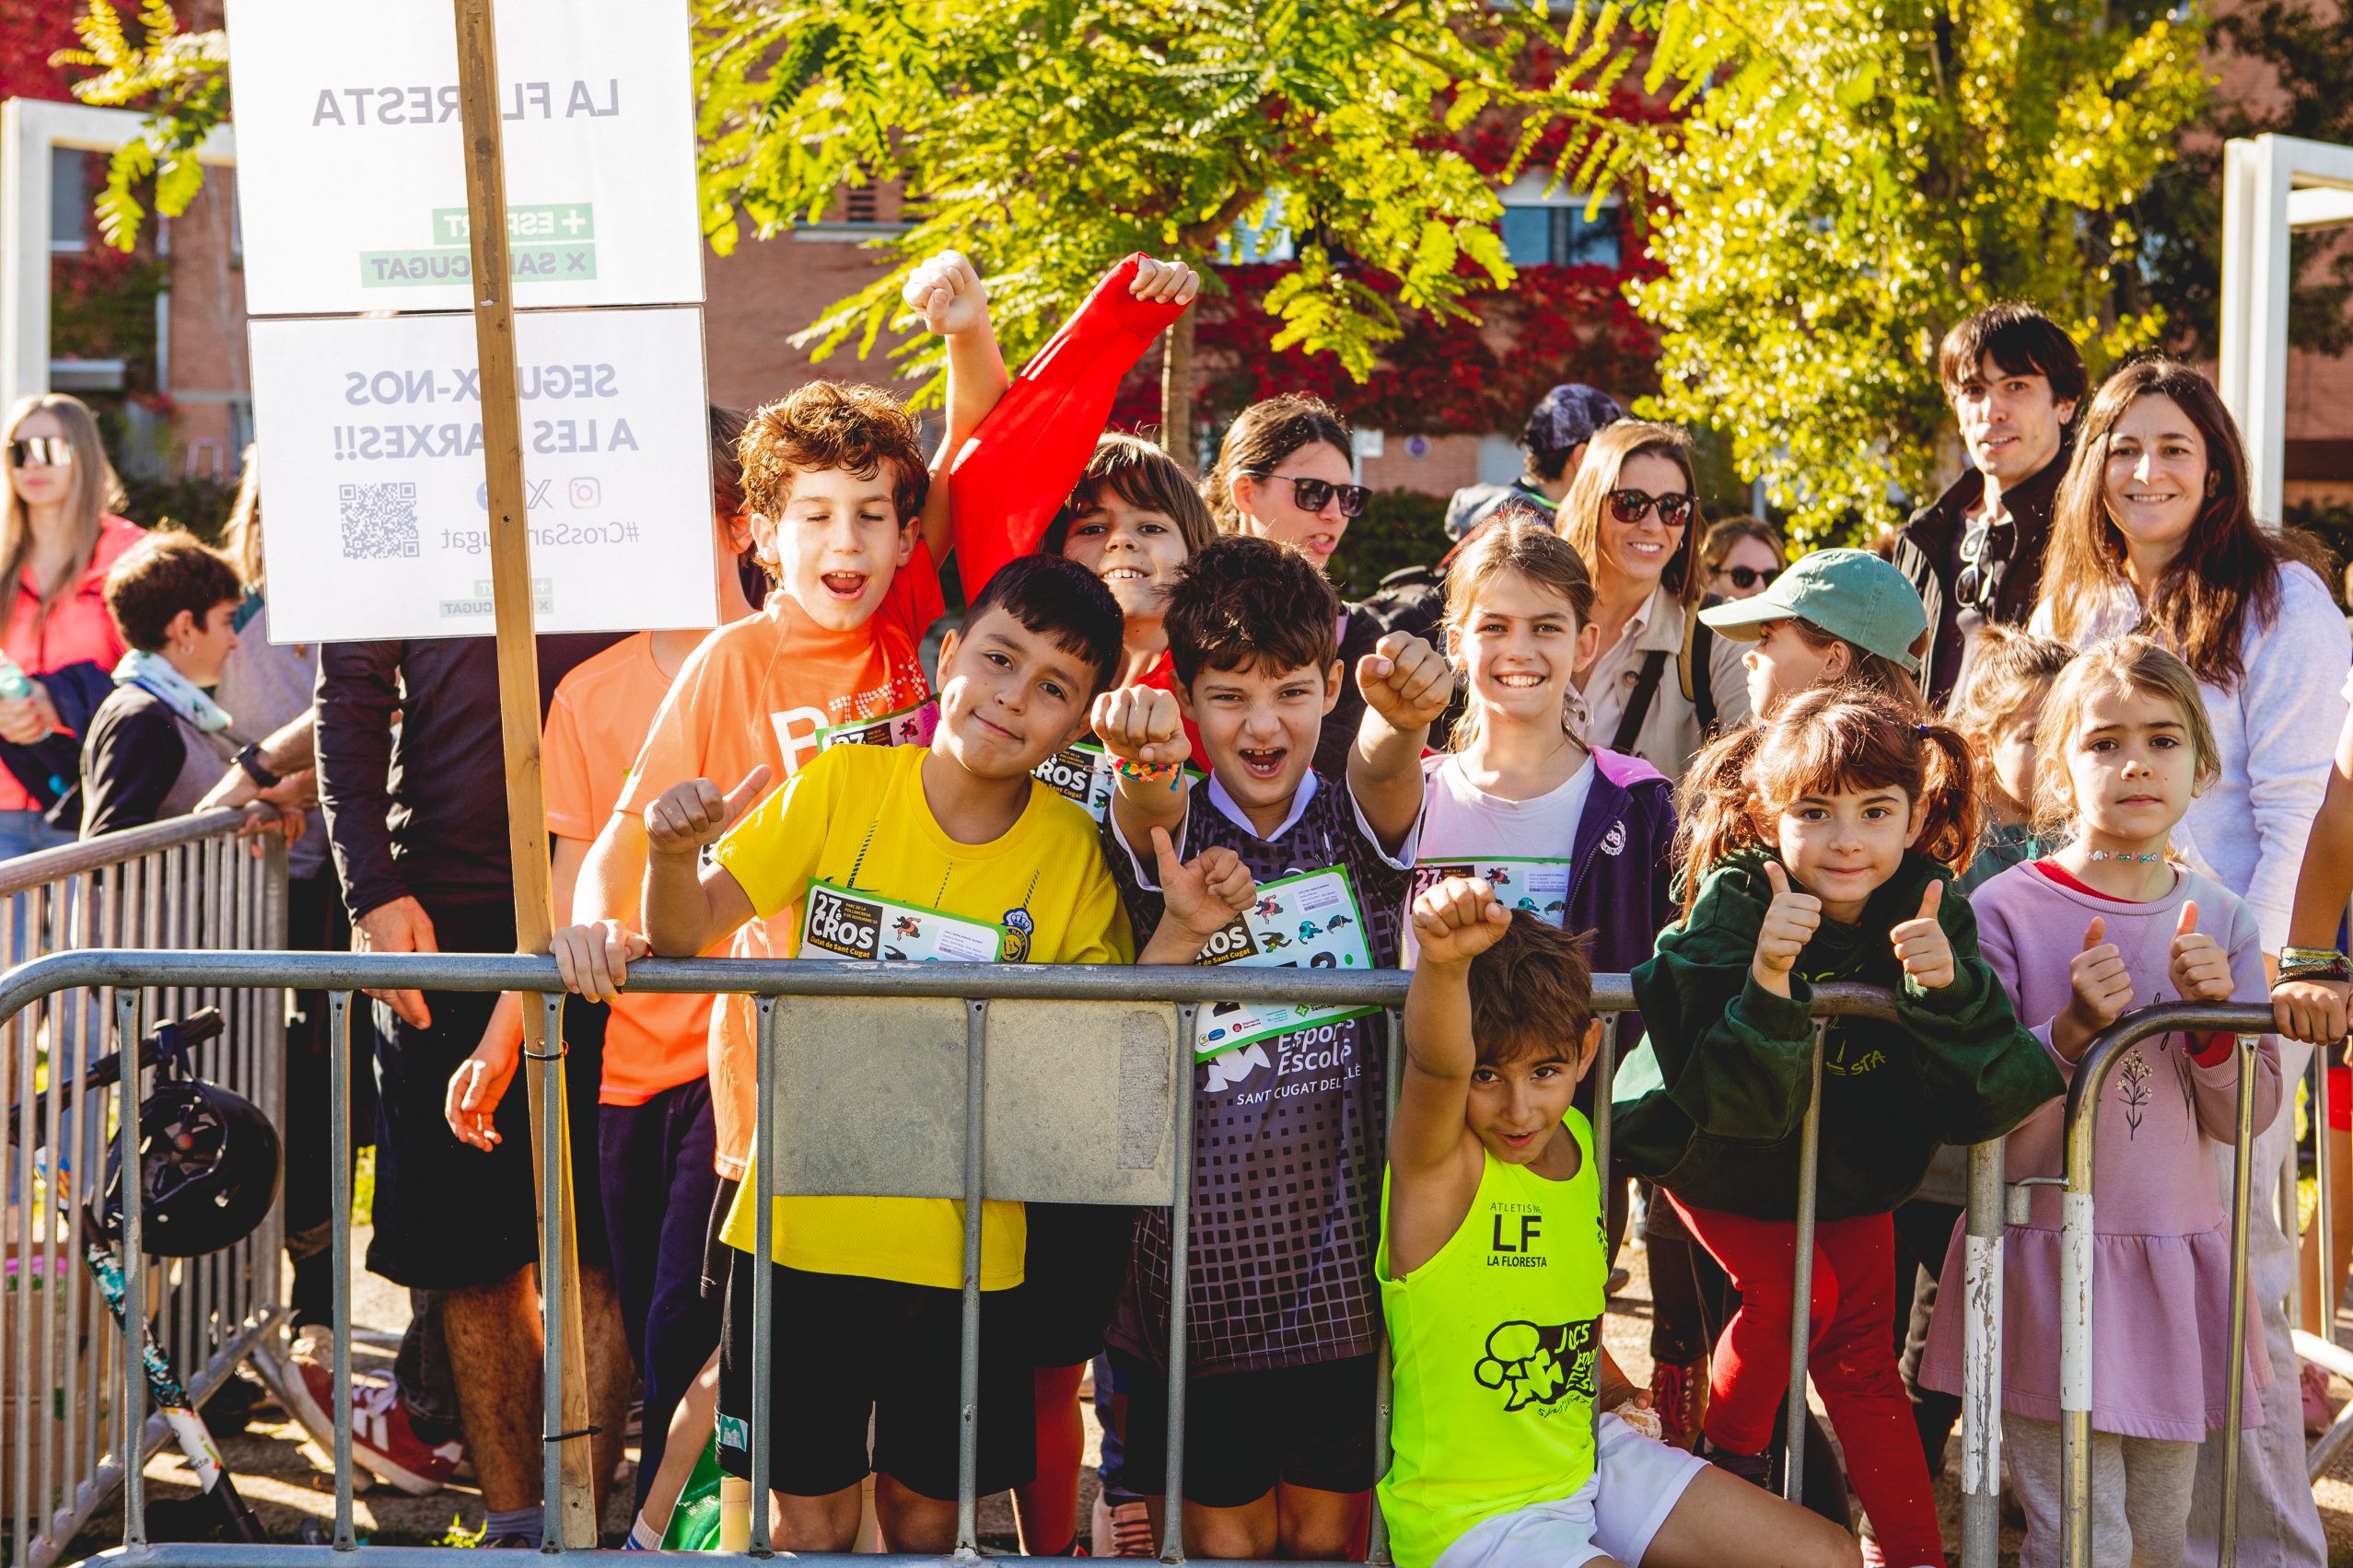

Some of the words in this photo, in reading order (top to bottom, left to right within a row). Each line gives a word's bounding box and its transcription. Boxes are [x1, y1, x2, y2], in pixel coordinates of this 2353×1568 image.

[1030, 759, 1087, 792] ROS
[811, 913, 876, 949] CROS
[825, 941, 833, 949] de
[833, 944, 849, 954] Sant
[850, 947, 870, 958] Cugat
[1213, 954, 1229, 964] Sant
[1229, 947, 1251, 958] Cugat
[1237, 1089, 1272, 1106] SANT
[1274, 1080, 1318, 1100] CUGAT
[1320, 1078, 1342, 1092] DEL
[1493, 1214, 1543, 1253] LF
[1487, 1255, 1499, 1266] LA
[1502, 1256, 1547, 1268] FLORESTA
